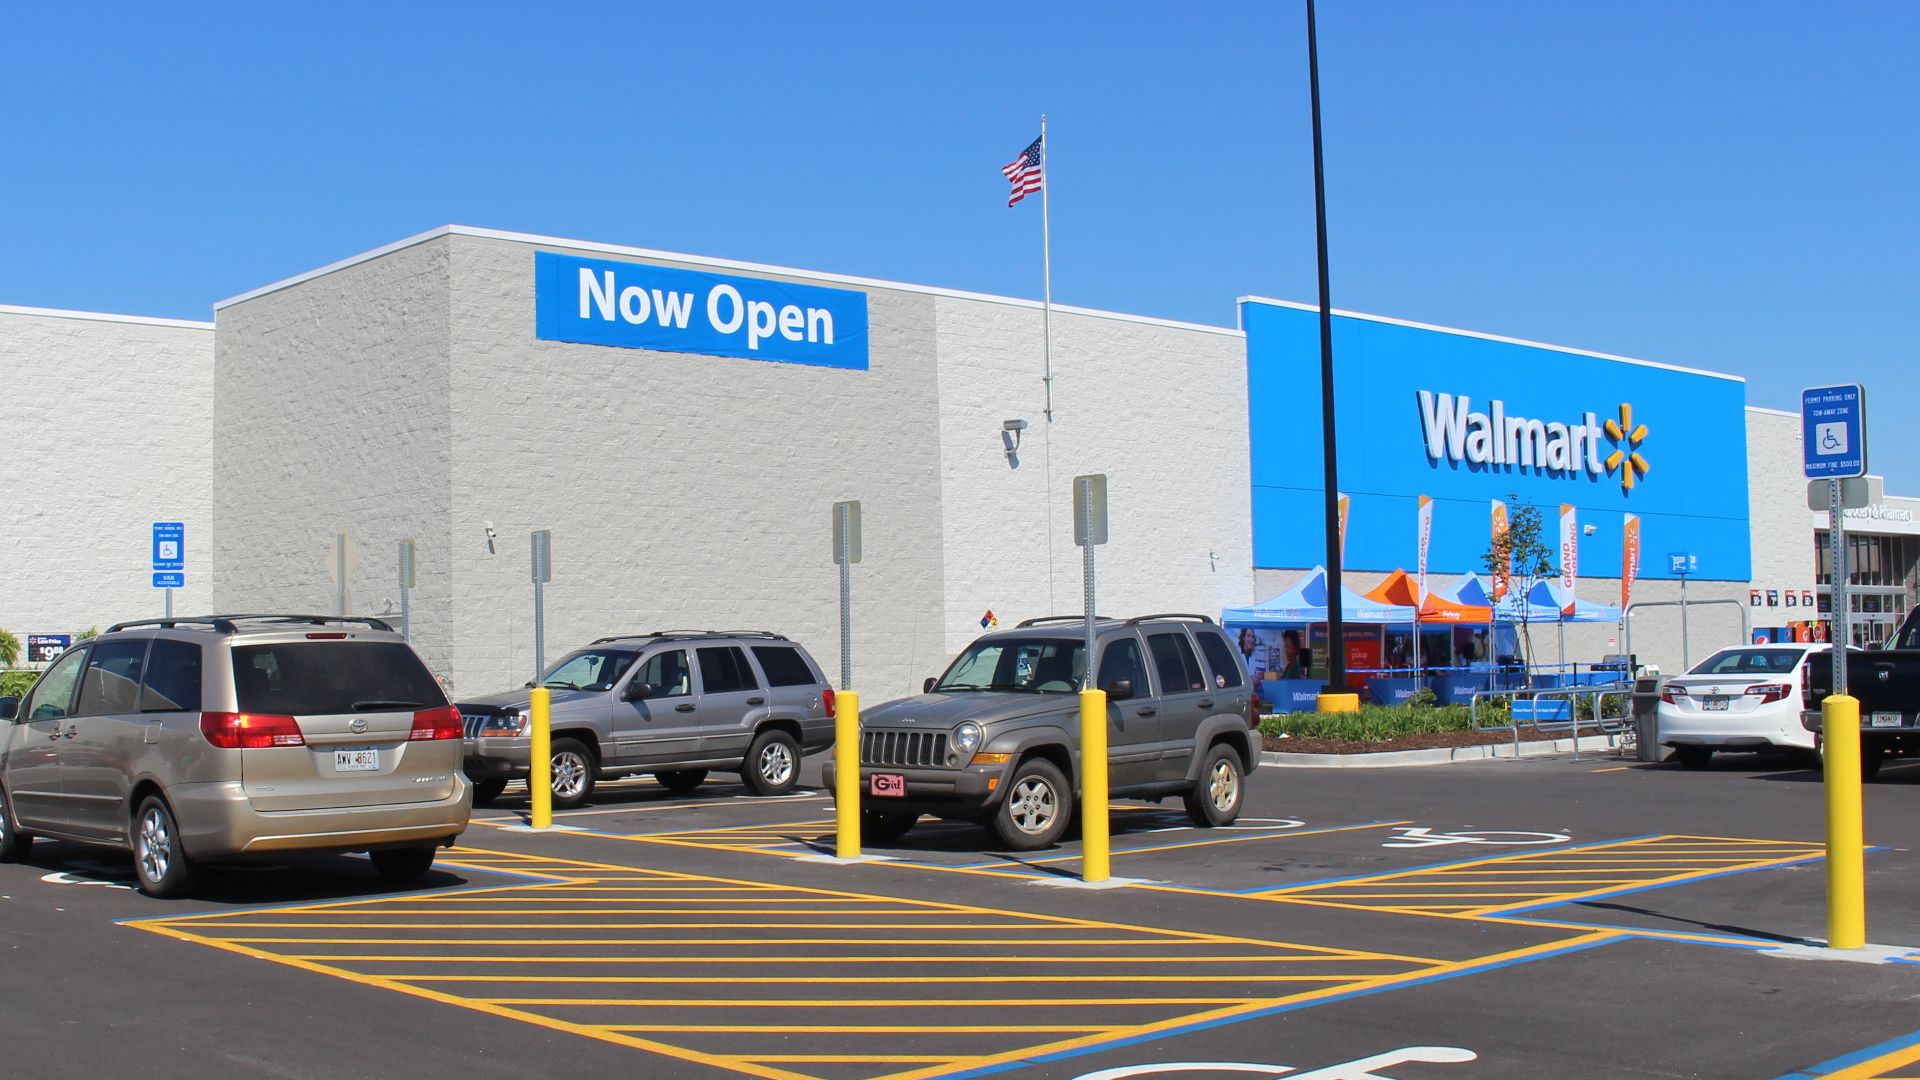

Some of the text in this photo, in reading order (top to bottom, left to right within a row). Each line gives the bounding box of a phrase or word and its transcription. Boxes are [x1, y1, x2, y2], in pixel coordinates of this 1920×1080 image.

[579, 267, 834, 350] Now Open
[1805, 393, 1857, 404] PERMIT PARKING ONLY
[1813, 407, 1849, 417] TOW-AWAY ZONE
[1416, 390, 1603, 473] Walmart
[1805, 462, 1826, 470] MAXIMUM
[1827, 461, 1838, 469] FINE
[1879, 504, 1913, 524] Pharmacy
[1564, 543, 1572, 588] GRAND
[992, 618, 997, 626] 2
[1454, 686, 1476, 695] Walmart
[357, 752, 376, 764] 8621
[875, 777, 902, 791] Girl
